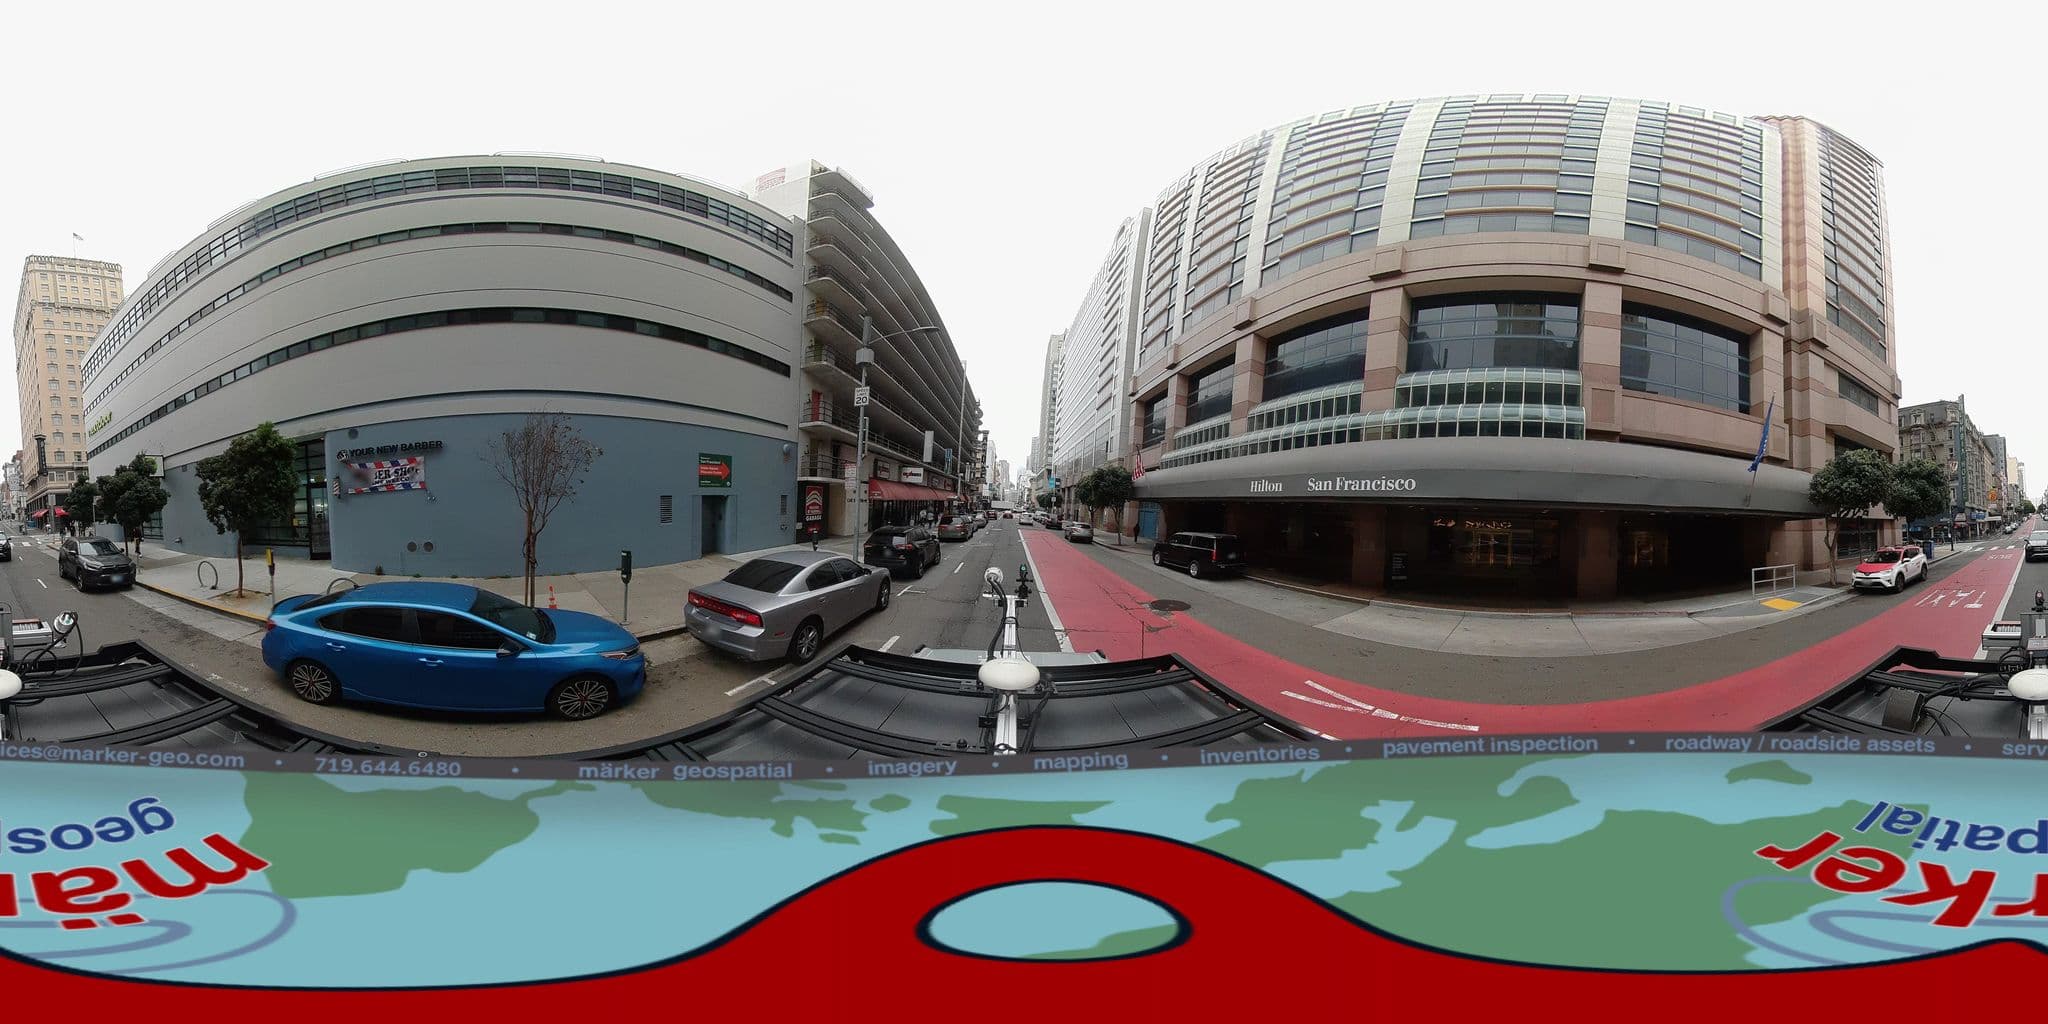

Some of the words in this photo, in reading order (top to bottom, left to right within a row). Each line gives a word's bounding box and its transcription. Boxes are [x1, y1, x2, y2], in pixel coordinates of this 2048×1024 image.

[856, 396, 868, 405] 20
[349, 447, 376, 458] YOUR
[376, 443, 399, 455] NEW
[401, 440, 443, 451] BARBER
[1250, 479, 1283, 493] Hilton
[1307, 477, 1333, 492] San
[1336, 475, 1417, 491] Francisco
[1915, 589, 1986, 609] TAXI
